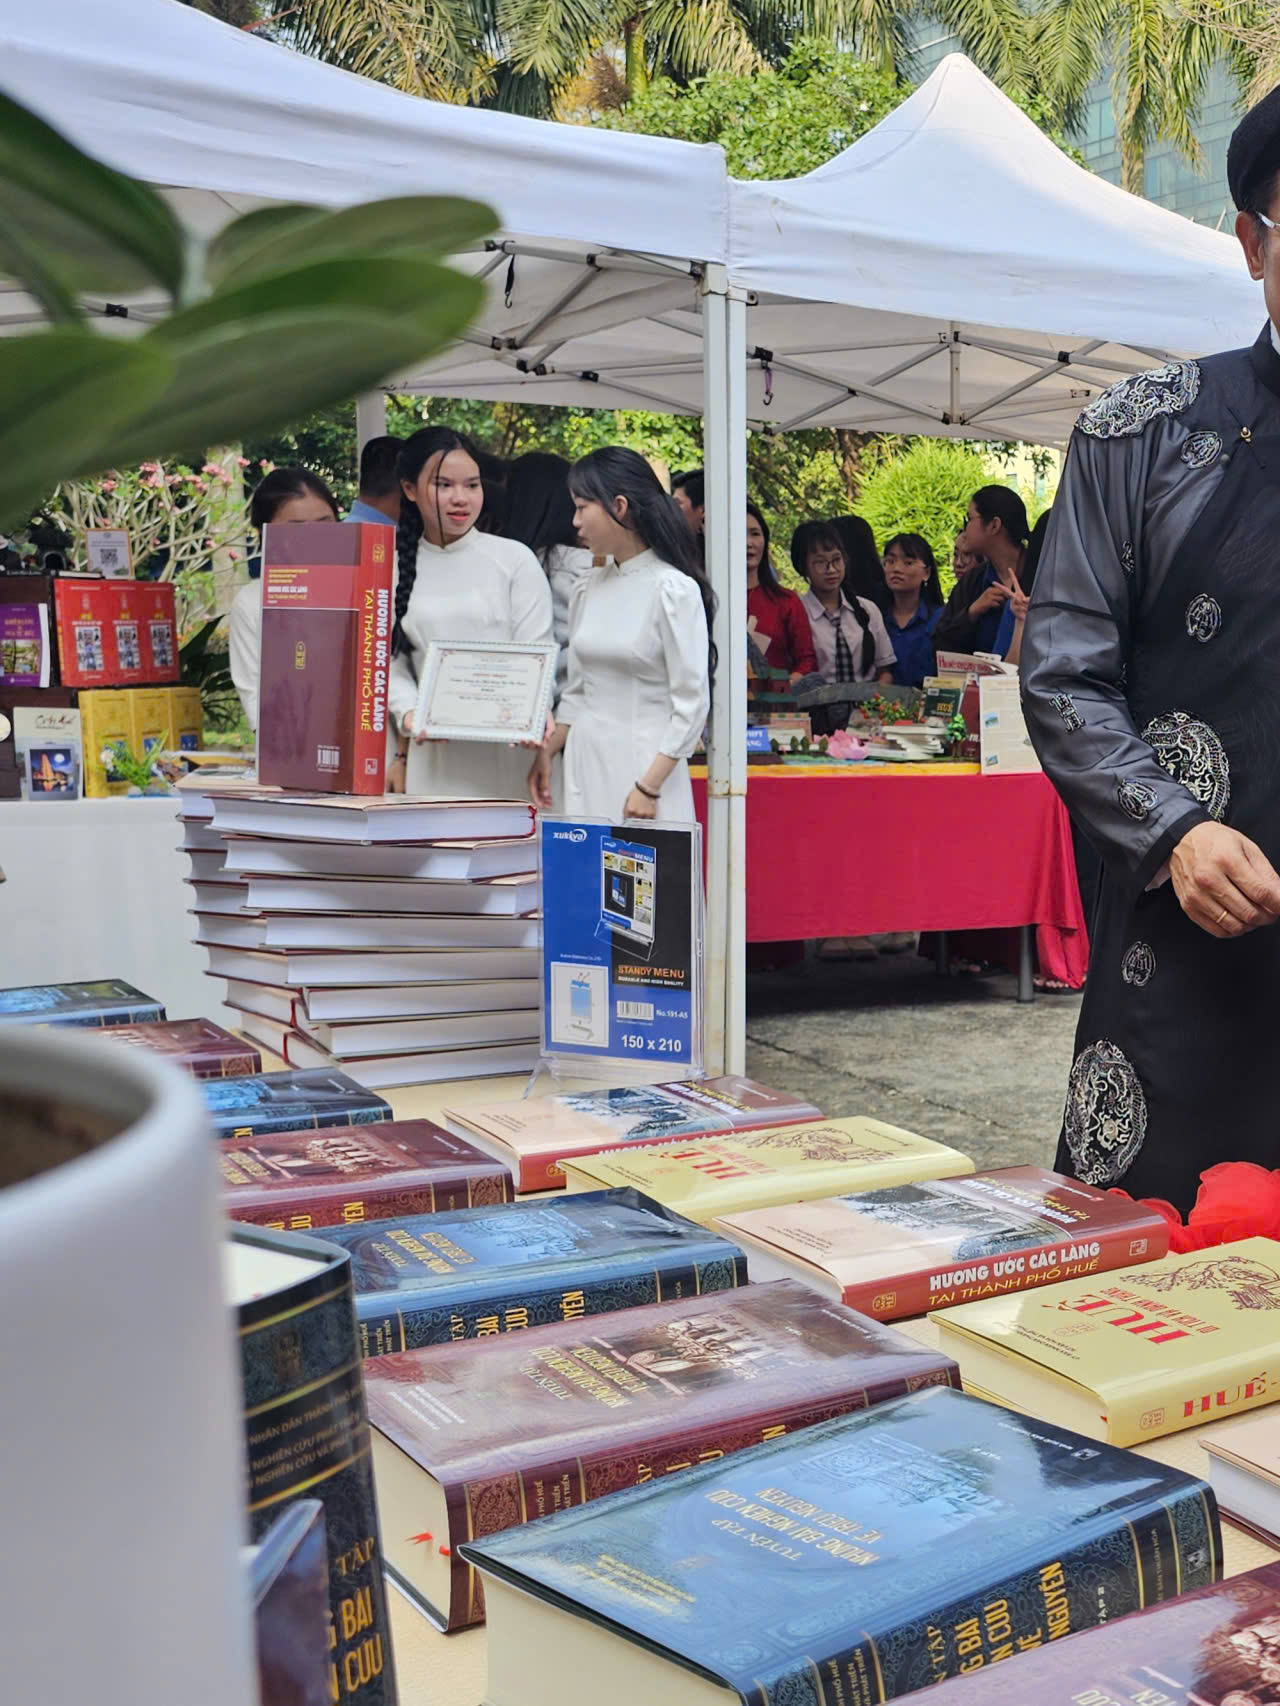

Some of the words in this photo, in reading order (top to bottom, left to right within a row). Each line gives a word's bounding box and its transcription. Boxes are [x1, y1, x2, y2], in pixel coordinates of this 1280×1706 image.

[364, 588, 374, 609] TẠI
[362, 614, 375, 662] THÀNH
[361, 668, 374, 698] PHỐ
[360, 702, 373, 731] HUẾ
[635, 853, 653, 862] MENU
[618, 965, 653, 976] STANDY
[654, 967, 684, 978] MENU
[656, 1010, 688, 1019] No.191-A5
[622, 1035, 643, 1048] 150
[648, 1040, 655, 1050] x
[659, 1039, 681, 1052] 210
[929, 1292, 955, 1305] TẠI
[960, 1278, 1021, 1298] THÀNH
[1026, 1266, 1061, 1284] PHỐ
[1066, 1257, 1100, 1275] HUẾ
[930, 1265, 990, 1291] HƯƠNG
[994, 1256, 1025, 1277] ƯỚC
[1029, 1249, 1056, 1269] CÁC
[1061, 1242, 1100, 1263] LÀNG
[1042, 1293, 1190, 1345] HUẾ
[1184, 1372, 1268, 1418] HUẾ
[702, 1487, 747, 1507] CỨU
[750, 1485, 825, 1517] NGUYỄN
[708, 1516, 748, 1534] TẬP
[733, 1502, 801, 1531] NGHIÊN
[808, 1510, 865, 1535] TRIỀU
[739, 1531, 806, 1560] TUYỂN
[785, 1525, 825, 1543] BÀI
[852, 1528, 886, 1544] VỀ
[336, 1538, 375, 1576] TẬP
[813, 1536, 881, 1565] NHỮNG
[1040, 1561, 1070, 1640] NGUYỄN
[983, 1598, 1014, 1643] CỨU
[927, 1625, 946, 1670] TẬP
[955, 1617, 982, 1655] BÀI
[345, 1633, 384, 1694] CỨU
